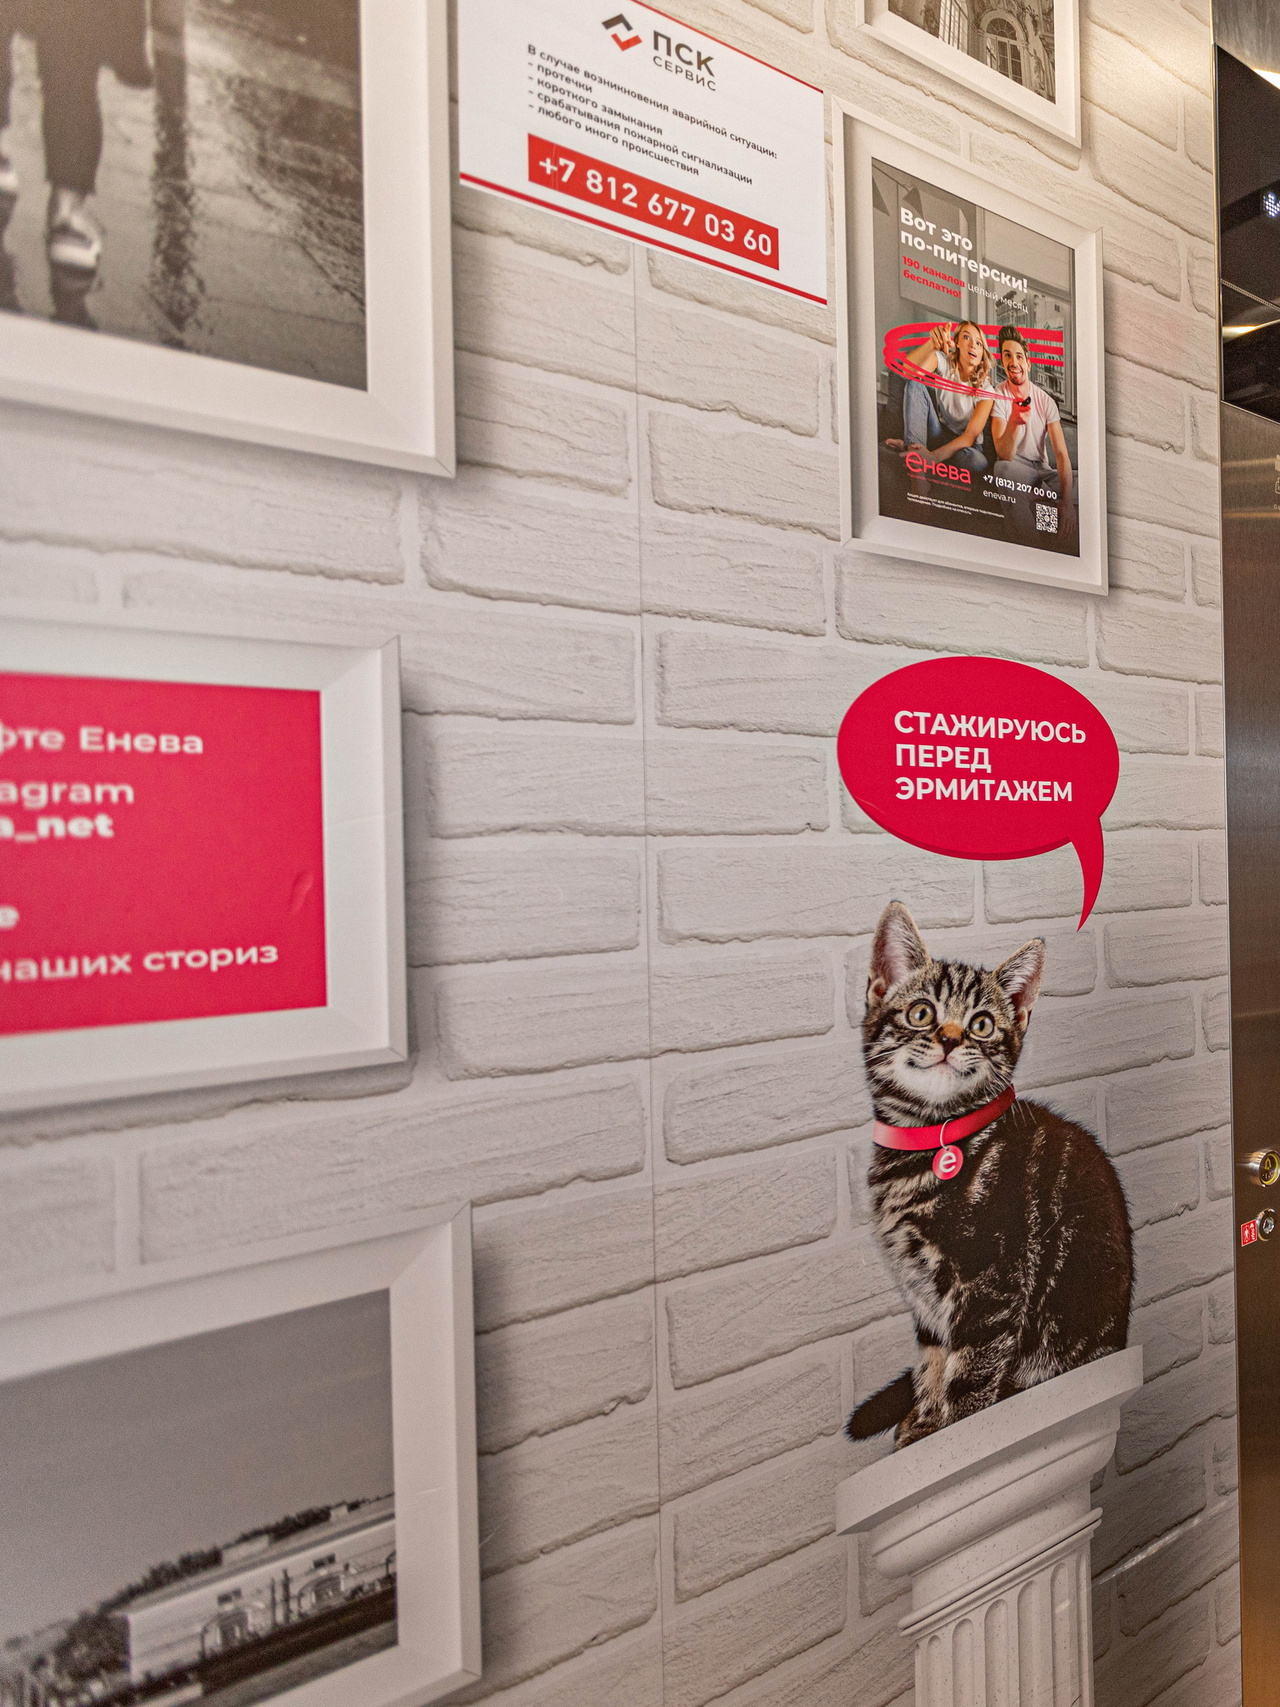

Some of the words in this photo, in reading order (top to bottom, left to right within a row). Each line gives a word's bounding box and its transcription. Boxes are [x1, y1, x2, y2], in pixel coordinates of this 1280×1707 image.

[653, 30, 715, 77] ПСК
[537, 64, 593, 93] протечки
[653, 55, 716, 91] СЕРВИС
[528, 44, 536, 55] В
[540, 51, 580, 74] случае
[584, 70, 669, 112] возникновения
[672, 107, 727, 137] аварийной
[730, 133, 778, 159] ситуации:
[537, 78, 598, 109] короткого
[601, 104, 663, 136] замыкания
[537, 92, 621, 131] срабатывания
[624, 127, 679, 155] пожарной
[681, 150, 753, 185] сигнализации
[538, 106, 582, 129] любого
[585, 125, 619, 144] иного
[621, 139, 699, 176] происшествия
[539, 157, 576, 183] +7
[586, 169, 638, 208] 812
[648, 193, 695, 227] 677
[705, 213, 735, 242] 03
[743, 229, 772, 256] 60
[900, 207, 936, 236] Вот
[941, 228, 973, 251] это
[900, 230, 1028, 293] по-питерски!
[902, 255, 920, 270] 190
[922, 265, 965, 288] каналов
[967, 283, 998, 301] целый
[1000, 296, 1029, 314] месяц
[903, 269, 962, 299] бесплатно!
[983, 474, 994, 484] +7
[995, 476, 1015, 491] (812)
[1016, 482, 1032, 494] 207
[1033, 487, 1045, 497] 00
[1046, 490, 1057, 500] 00
[983, 490, 1017, 504] eneva.ru
[79, 726, 204, 755] Енева
[894, 710, 1086, 743] СТАЖИРУЮСЬ
[895, 743, 992, 773] ПЕРЕД
[895, 777, 1072, 802] ЭРМИТАЖЕМ
[143, 945, 278, 973] сториз
